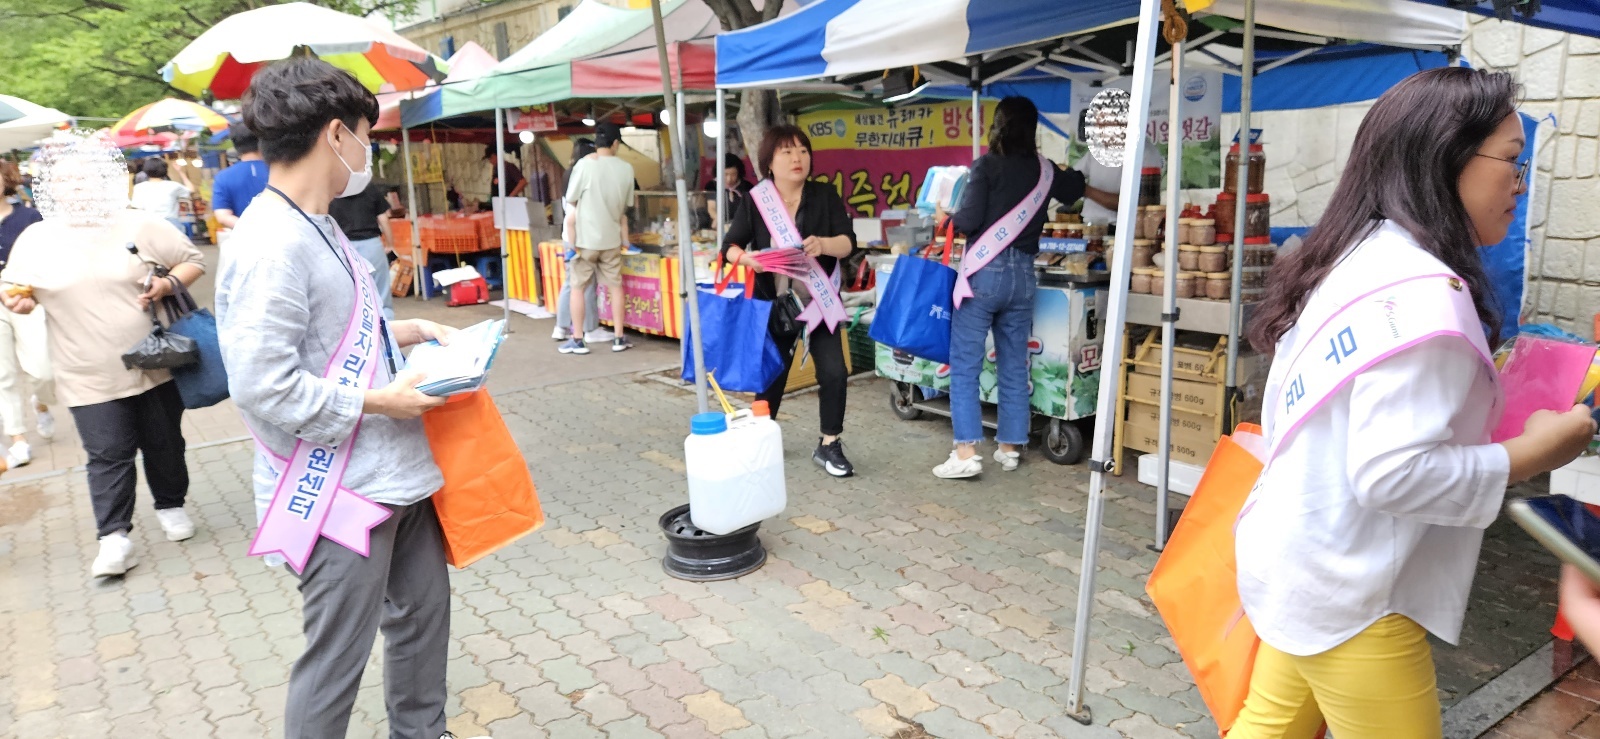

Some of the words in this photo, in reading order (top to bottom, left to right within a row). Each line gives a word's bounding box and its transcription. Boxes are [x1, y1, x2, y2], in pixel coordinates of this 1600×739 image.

[886, 107, 933, 129] 유레카
[943, 105, 985, 139] 방영
[808, 121, 833, 138] KBS
[1184, 394, 1205, 405] 600g
[1182, 420, 1202, 431] 600g
[1177, 445, 1196, 457] 600g
